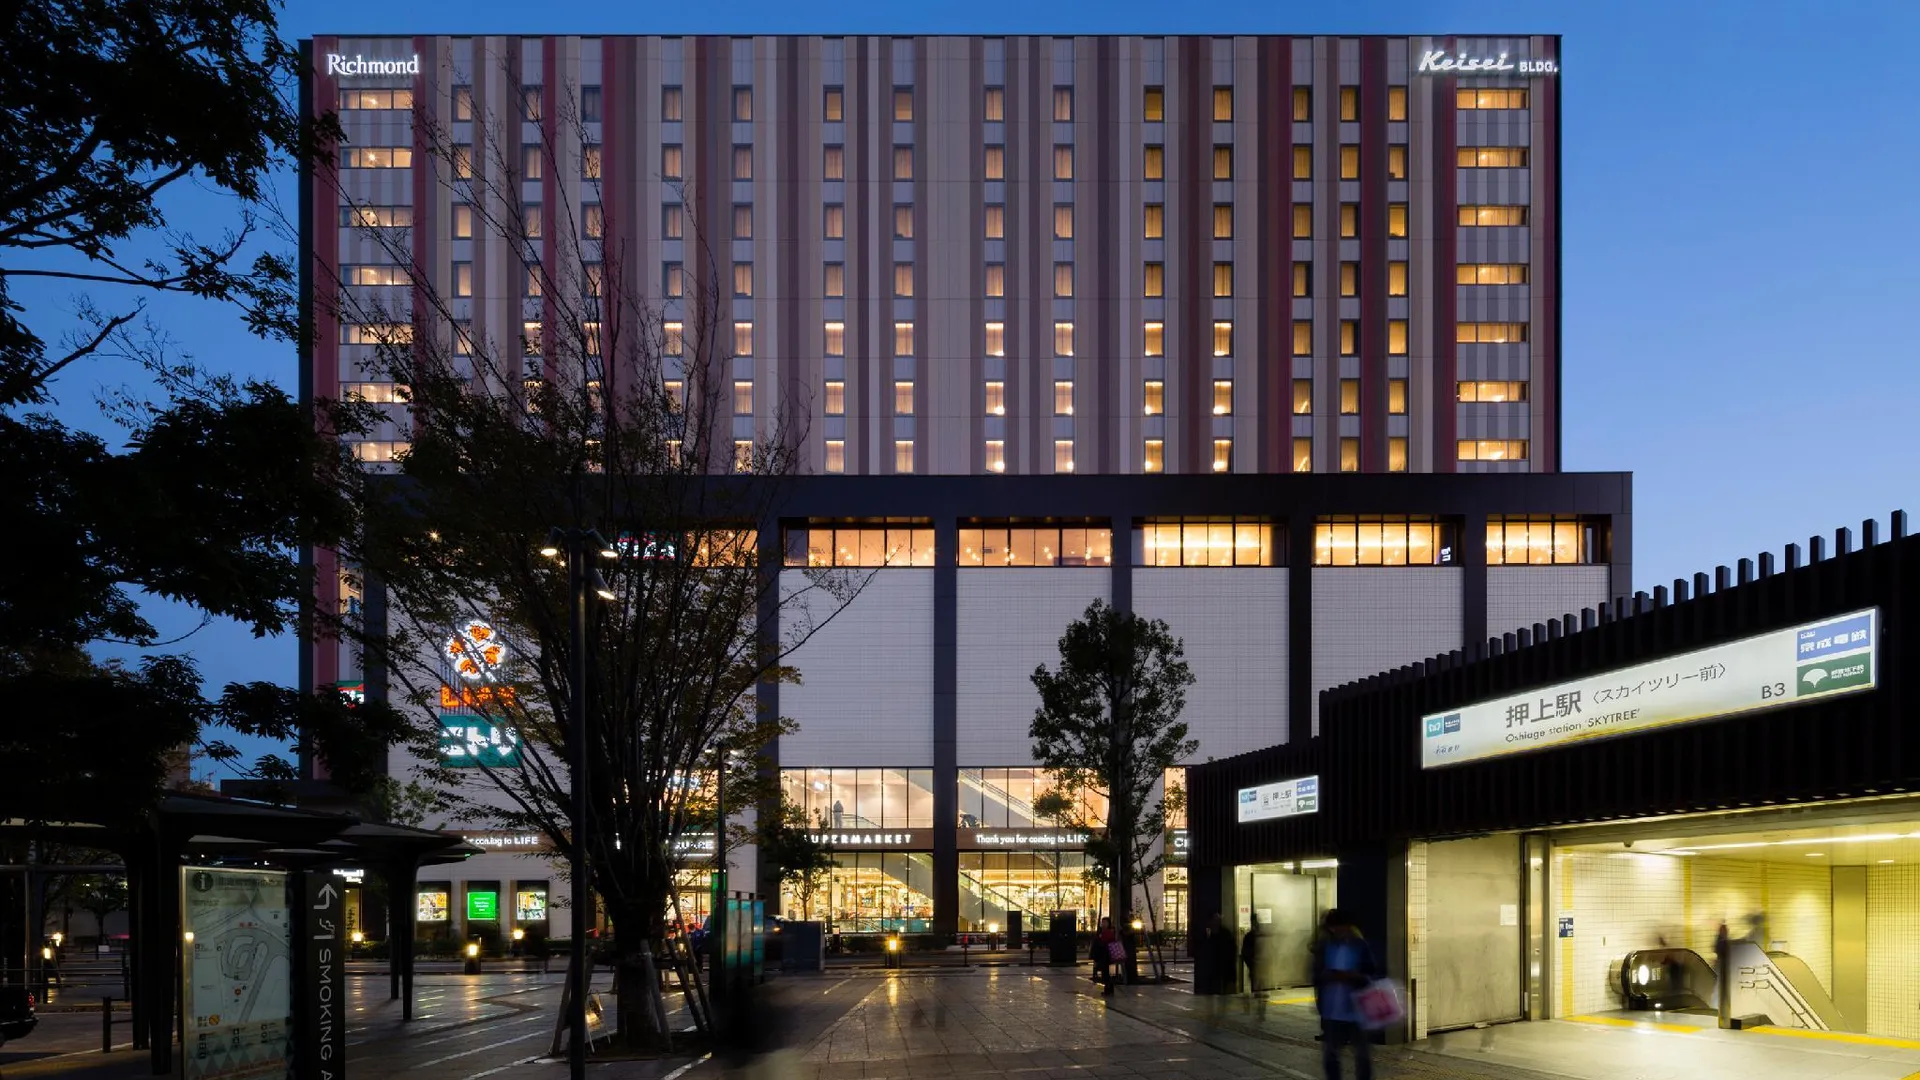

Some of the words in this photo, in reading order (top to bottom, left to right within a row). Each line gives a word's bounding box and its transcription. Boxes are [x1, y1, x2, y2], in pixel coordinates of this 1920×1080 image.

[327, 53, 419, 75] Richmond
[1419, 50, 1514, 71] Keisei
[1519, 61, 1558, 73] BLDG.
[1761, 682, 1786, 700] B3
[1505, 690, 1582, 728] 押上駅
[1505, 731, 1546, 743] Oshiage
[1549, 722, 1582, 736] station
[514, 836, 538, 845] LIFE
[976, 834, 999, 843] Thank
[1000, 836, 1015, 845] you
[1015, 834, 1027, 843] for
[1029, 834, 1055, 845] coming
[1057, 834, 1065, 843] to
[319, 948, 333, 1061] SMOKING
